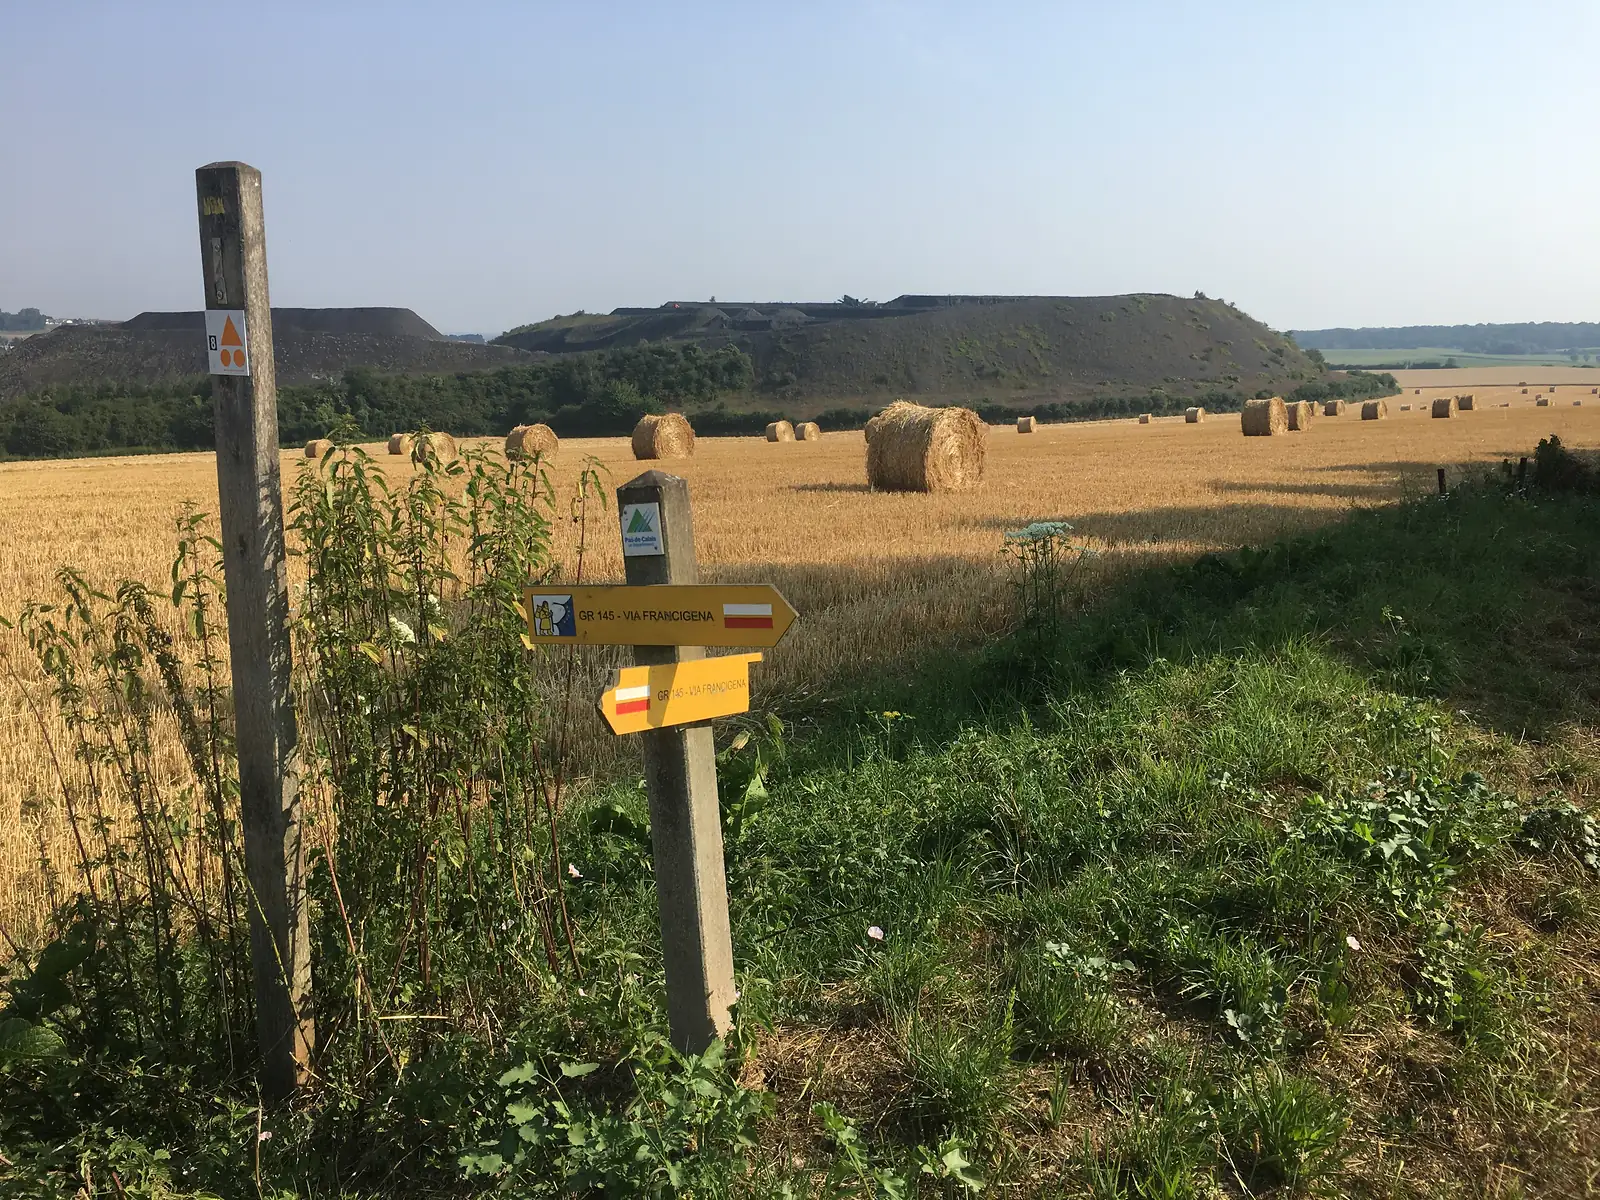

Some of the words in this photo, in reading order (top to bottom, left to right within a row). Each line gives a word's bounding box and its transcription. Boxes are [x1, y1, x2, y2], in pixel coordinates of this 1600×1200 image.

[210, 336, 216, 349] 8
[578, 611, 594, 621] GR
[597, 611, 615, 621] 145
[623, 611, 641, 621] VIA
[643, 611, 714, 621] FRANCIGENA
[657, 689, 670, 701] GR
[672, 687, 684, 700] 145
[689, 684, 701, 697] VIA
[702, 678, 747, 695] FRANCIGENA
